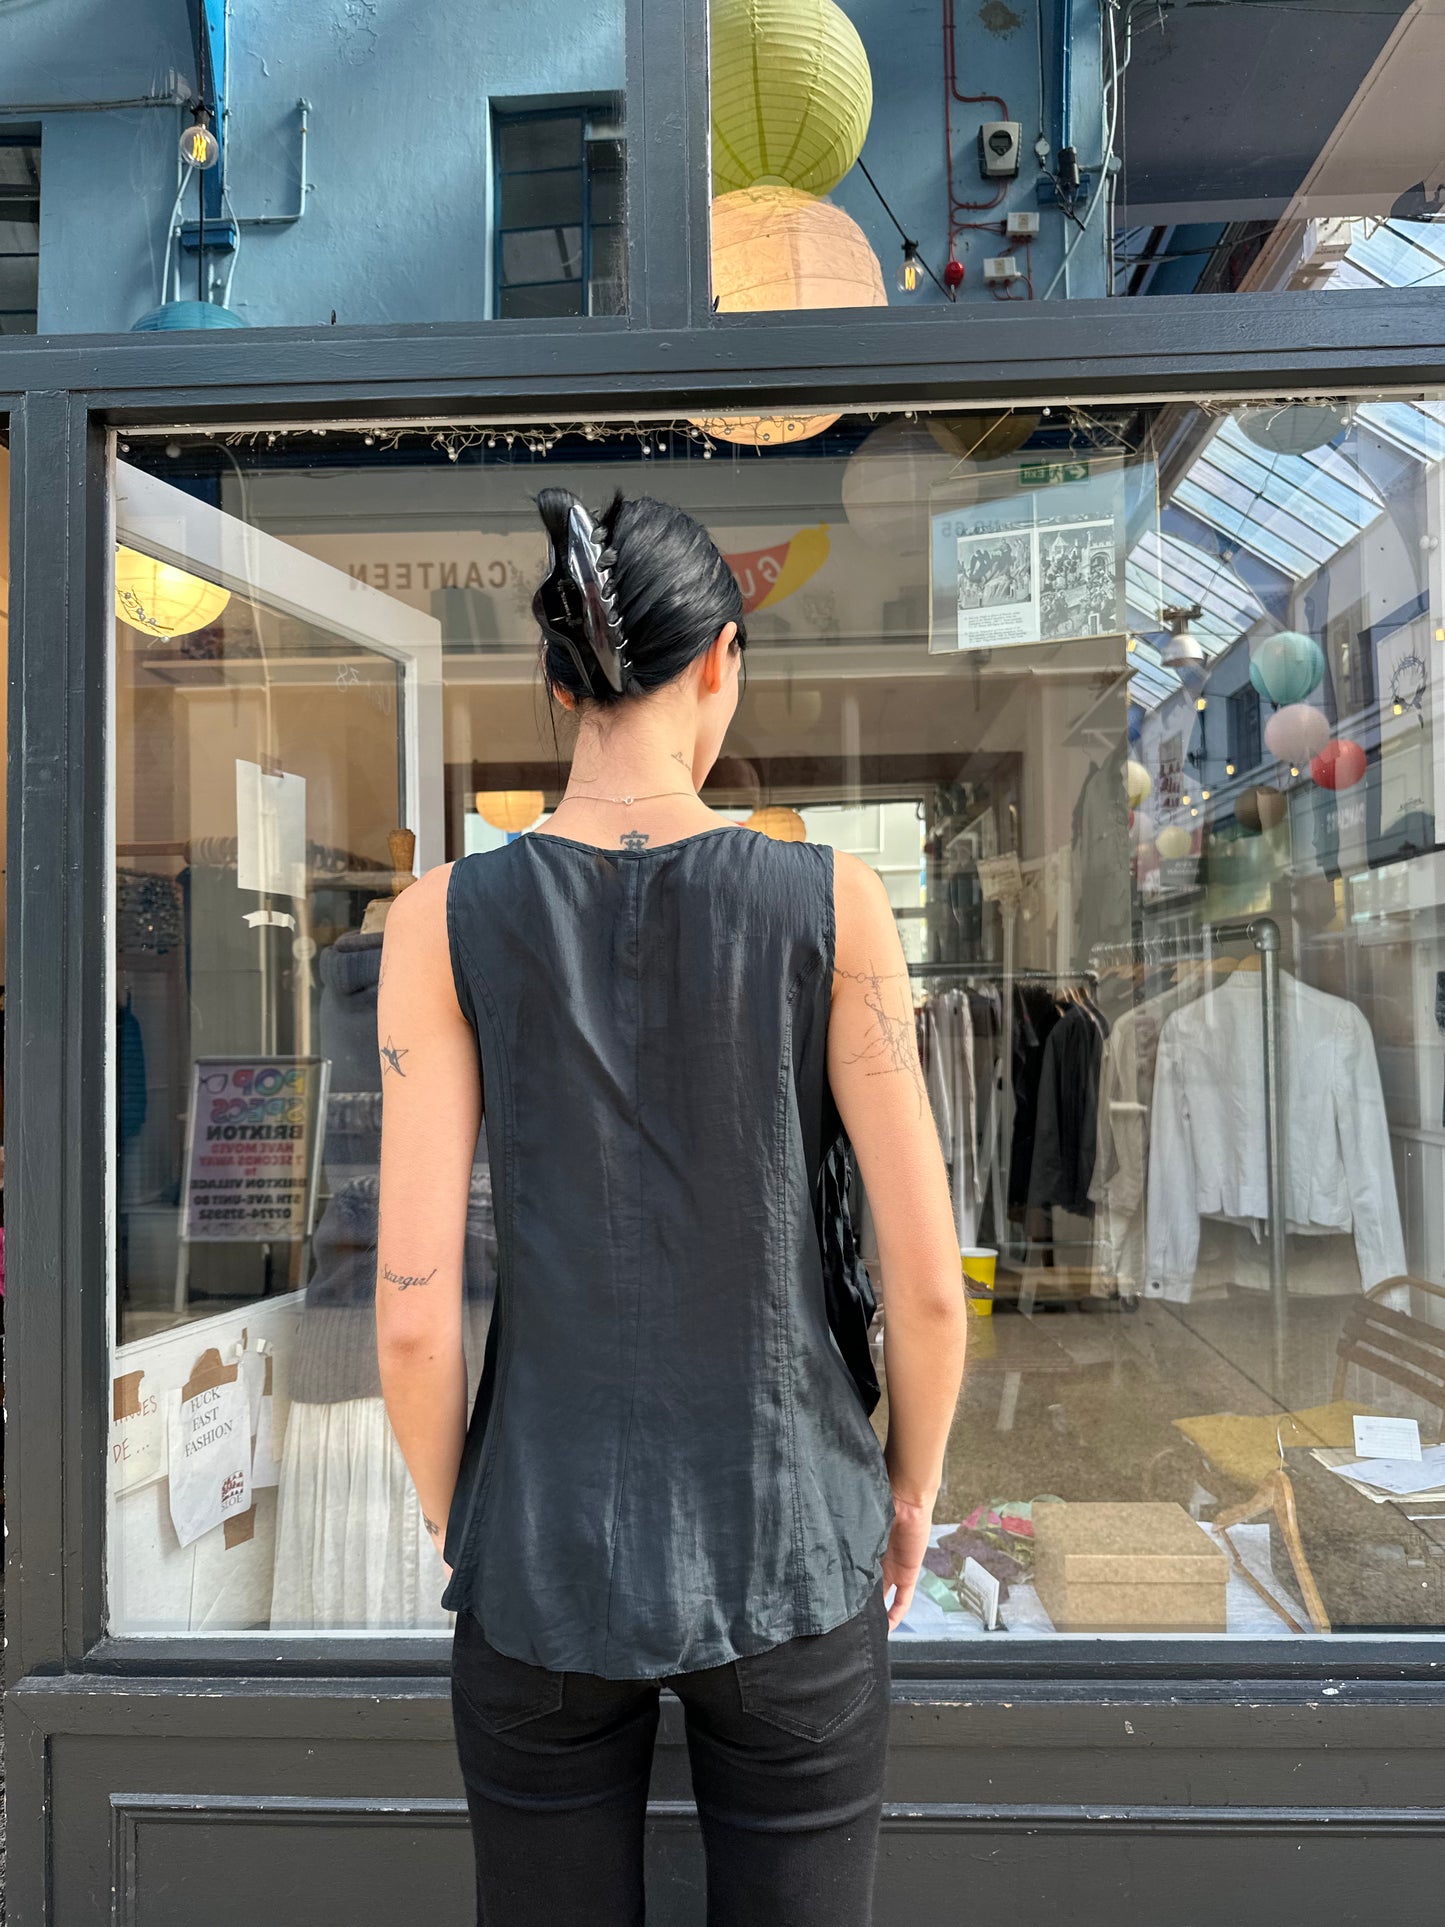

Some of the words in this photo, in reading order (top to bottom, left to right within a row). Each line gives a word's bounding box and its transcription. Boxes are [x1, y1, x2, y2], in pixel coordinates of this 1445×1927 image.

[191, 1386, 220, 1412] FUCK
[193, 1406, 219, 1431] FAST
[113, 1438, 131, 1463] DE
[184, 1420, 232, 1457] FASHION
